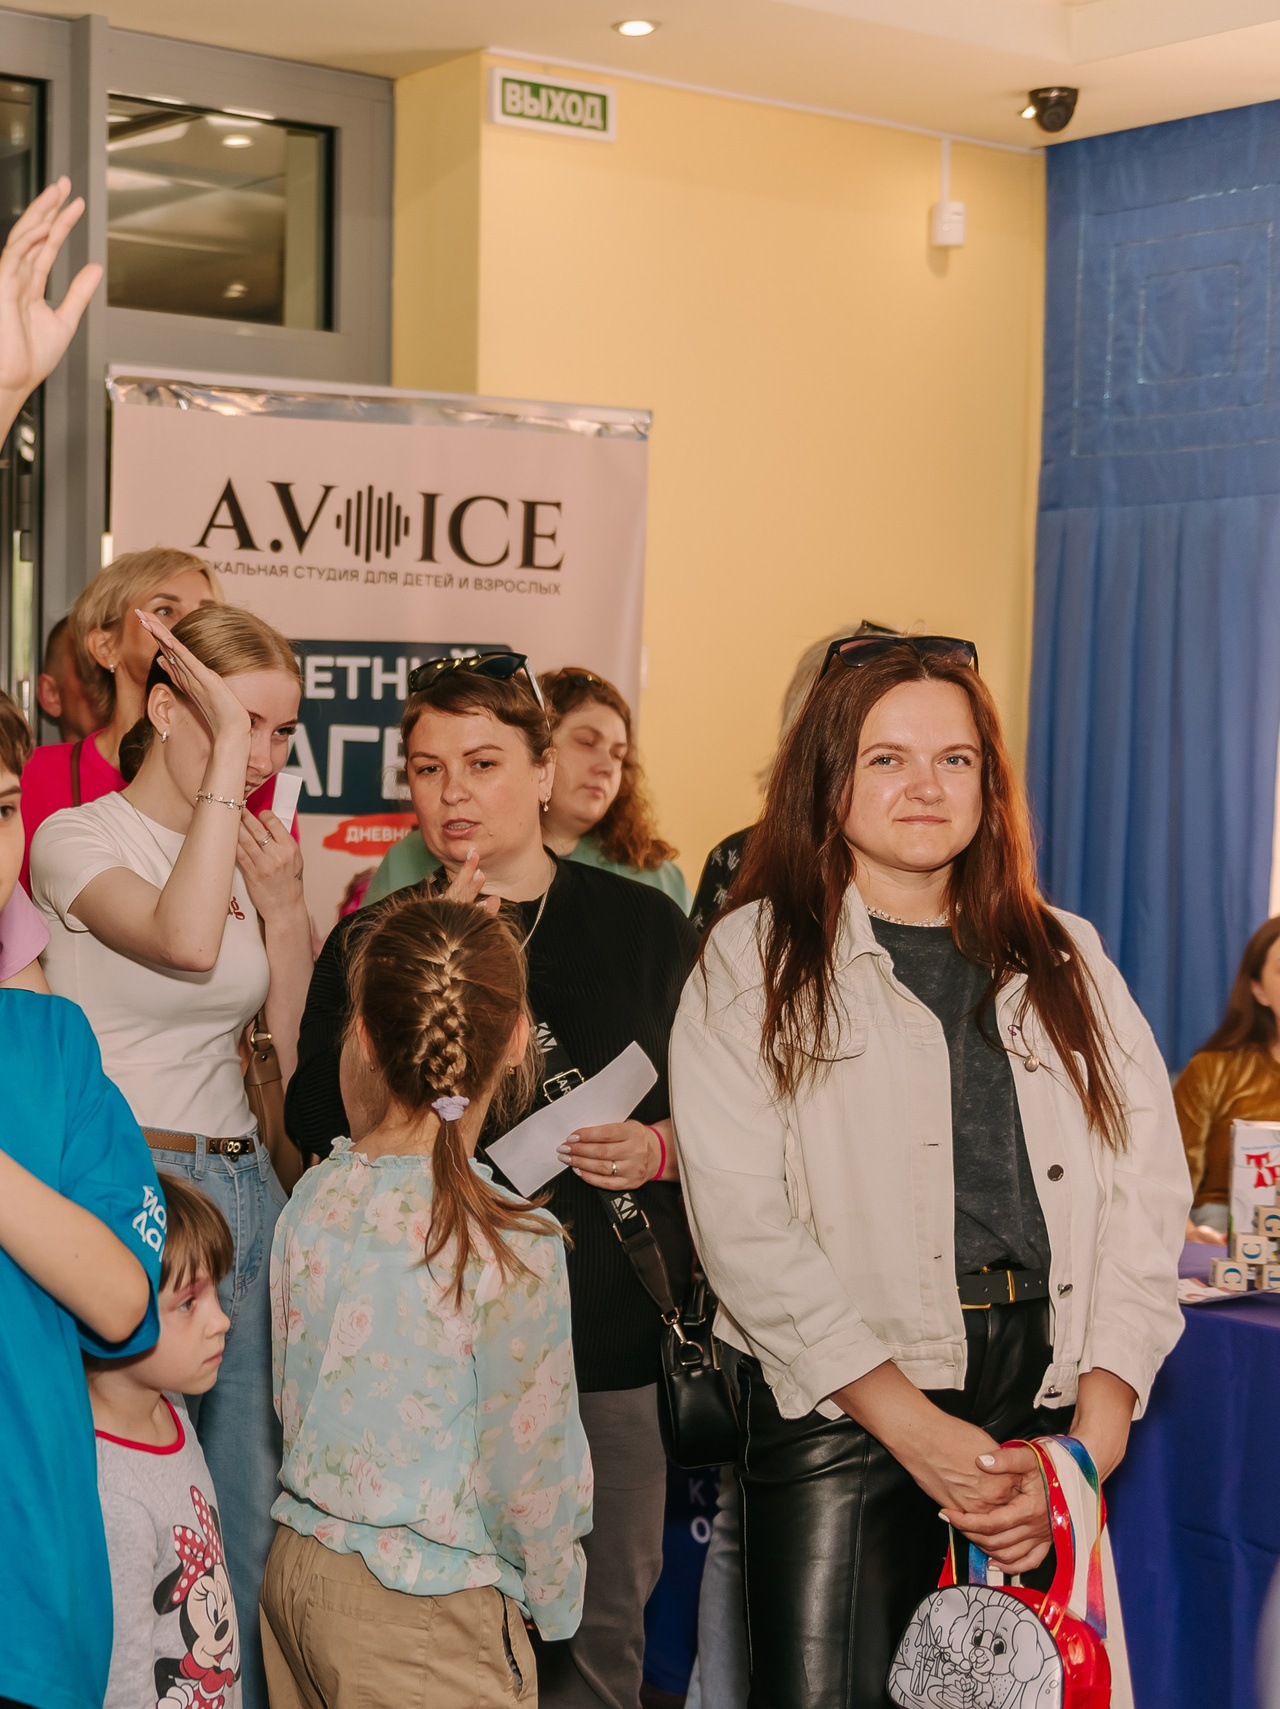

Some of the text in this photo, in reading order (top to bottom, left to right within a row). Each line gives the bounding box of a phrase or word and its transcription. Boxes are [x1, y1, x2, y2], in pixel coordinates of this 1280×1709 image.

[505, 82, 603, 129] ВЫХОД
[294, 565, 359, 582] СТУДИЯ
[364, 570, 399, 585] ДЛЯ
[403, 573, 454, 589] ДЕТЕЙ
[459, 577, 469, 590] И
[474, 578, 561, 596] ВЗРОСЛЫХ
